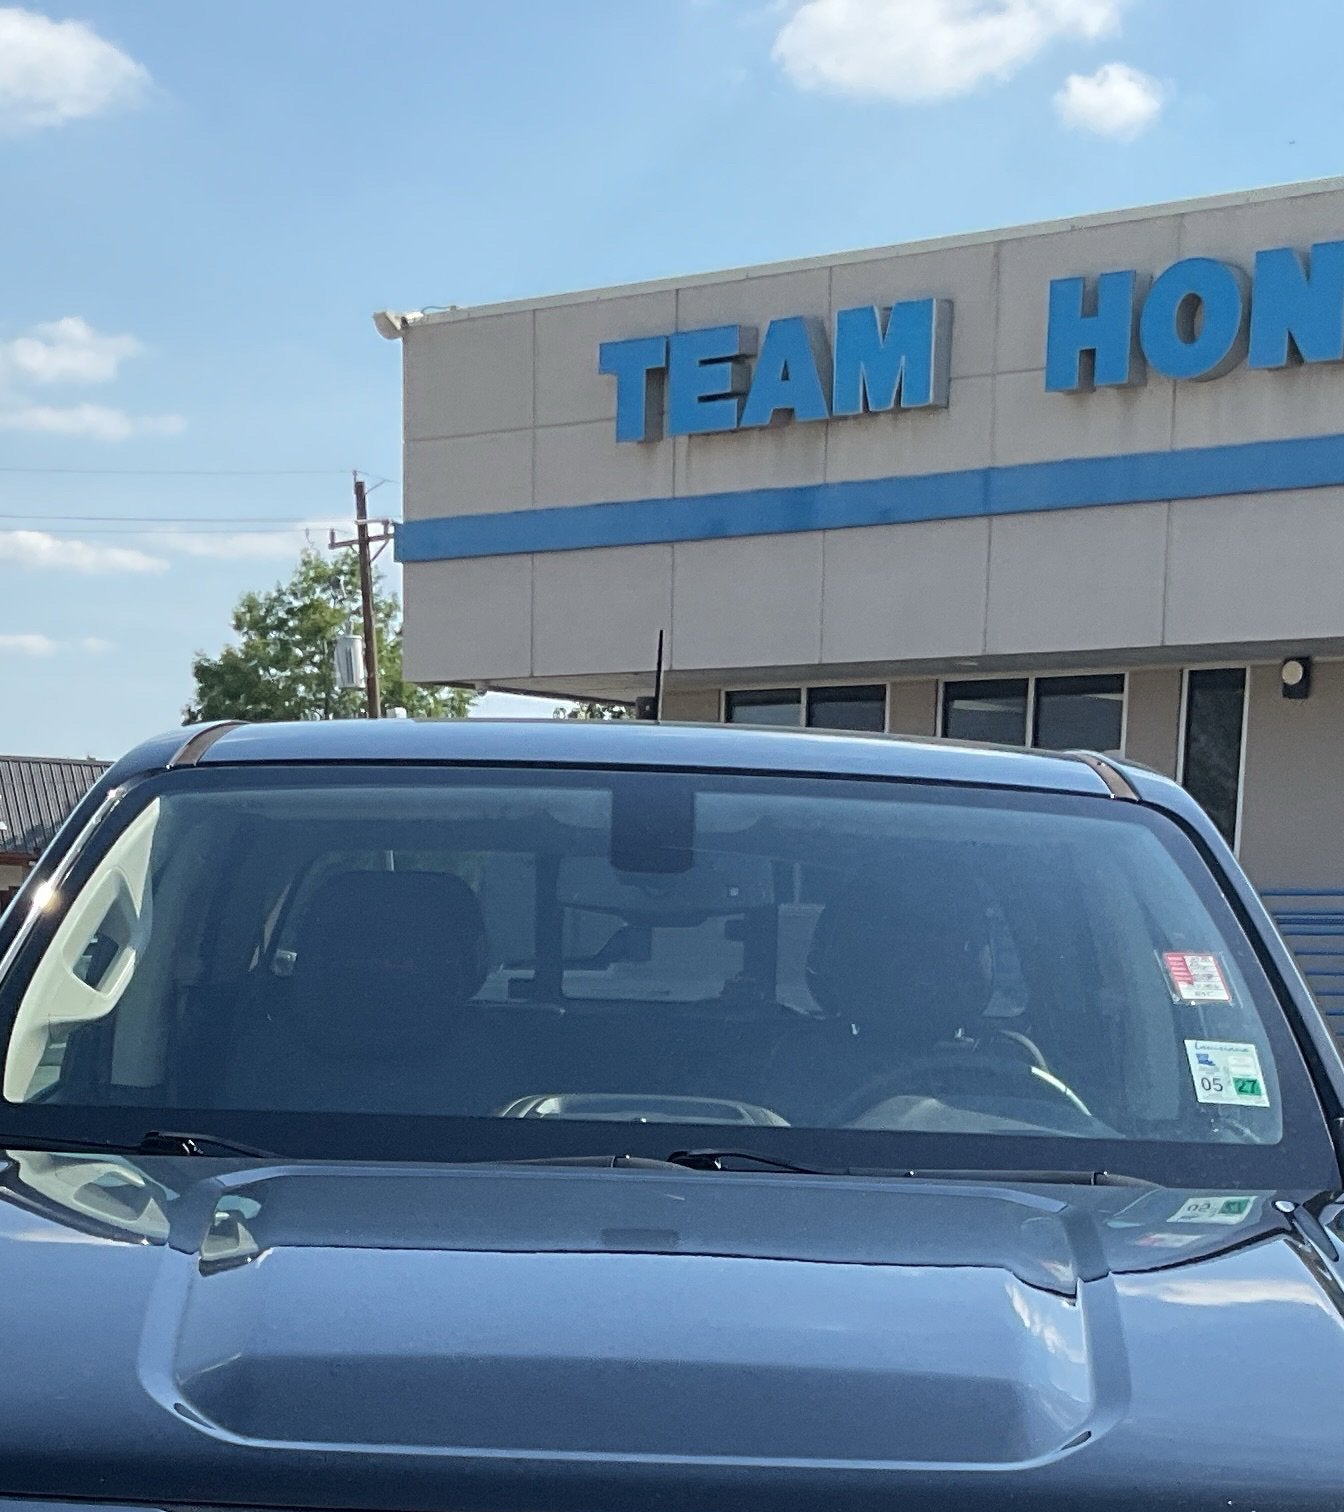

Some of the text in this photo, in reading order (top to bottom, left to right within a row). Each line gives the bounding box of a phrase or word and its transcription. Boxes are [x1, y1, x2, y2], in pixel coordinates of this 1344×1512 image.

[599, 298, 949, 444] TEAM
[1200, 1076, 1258, 1094] 05 27
